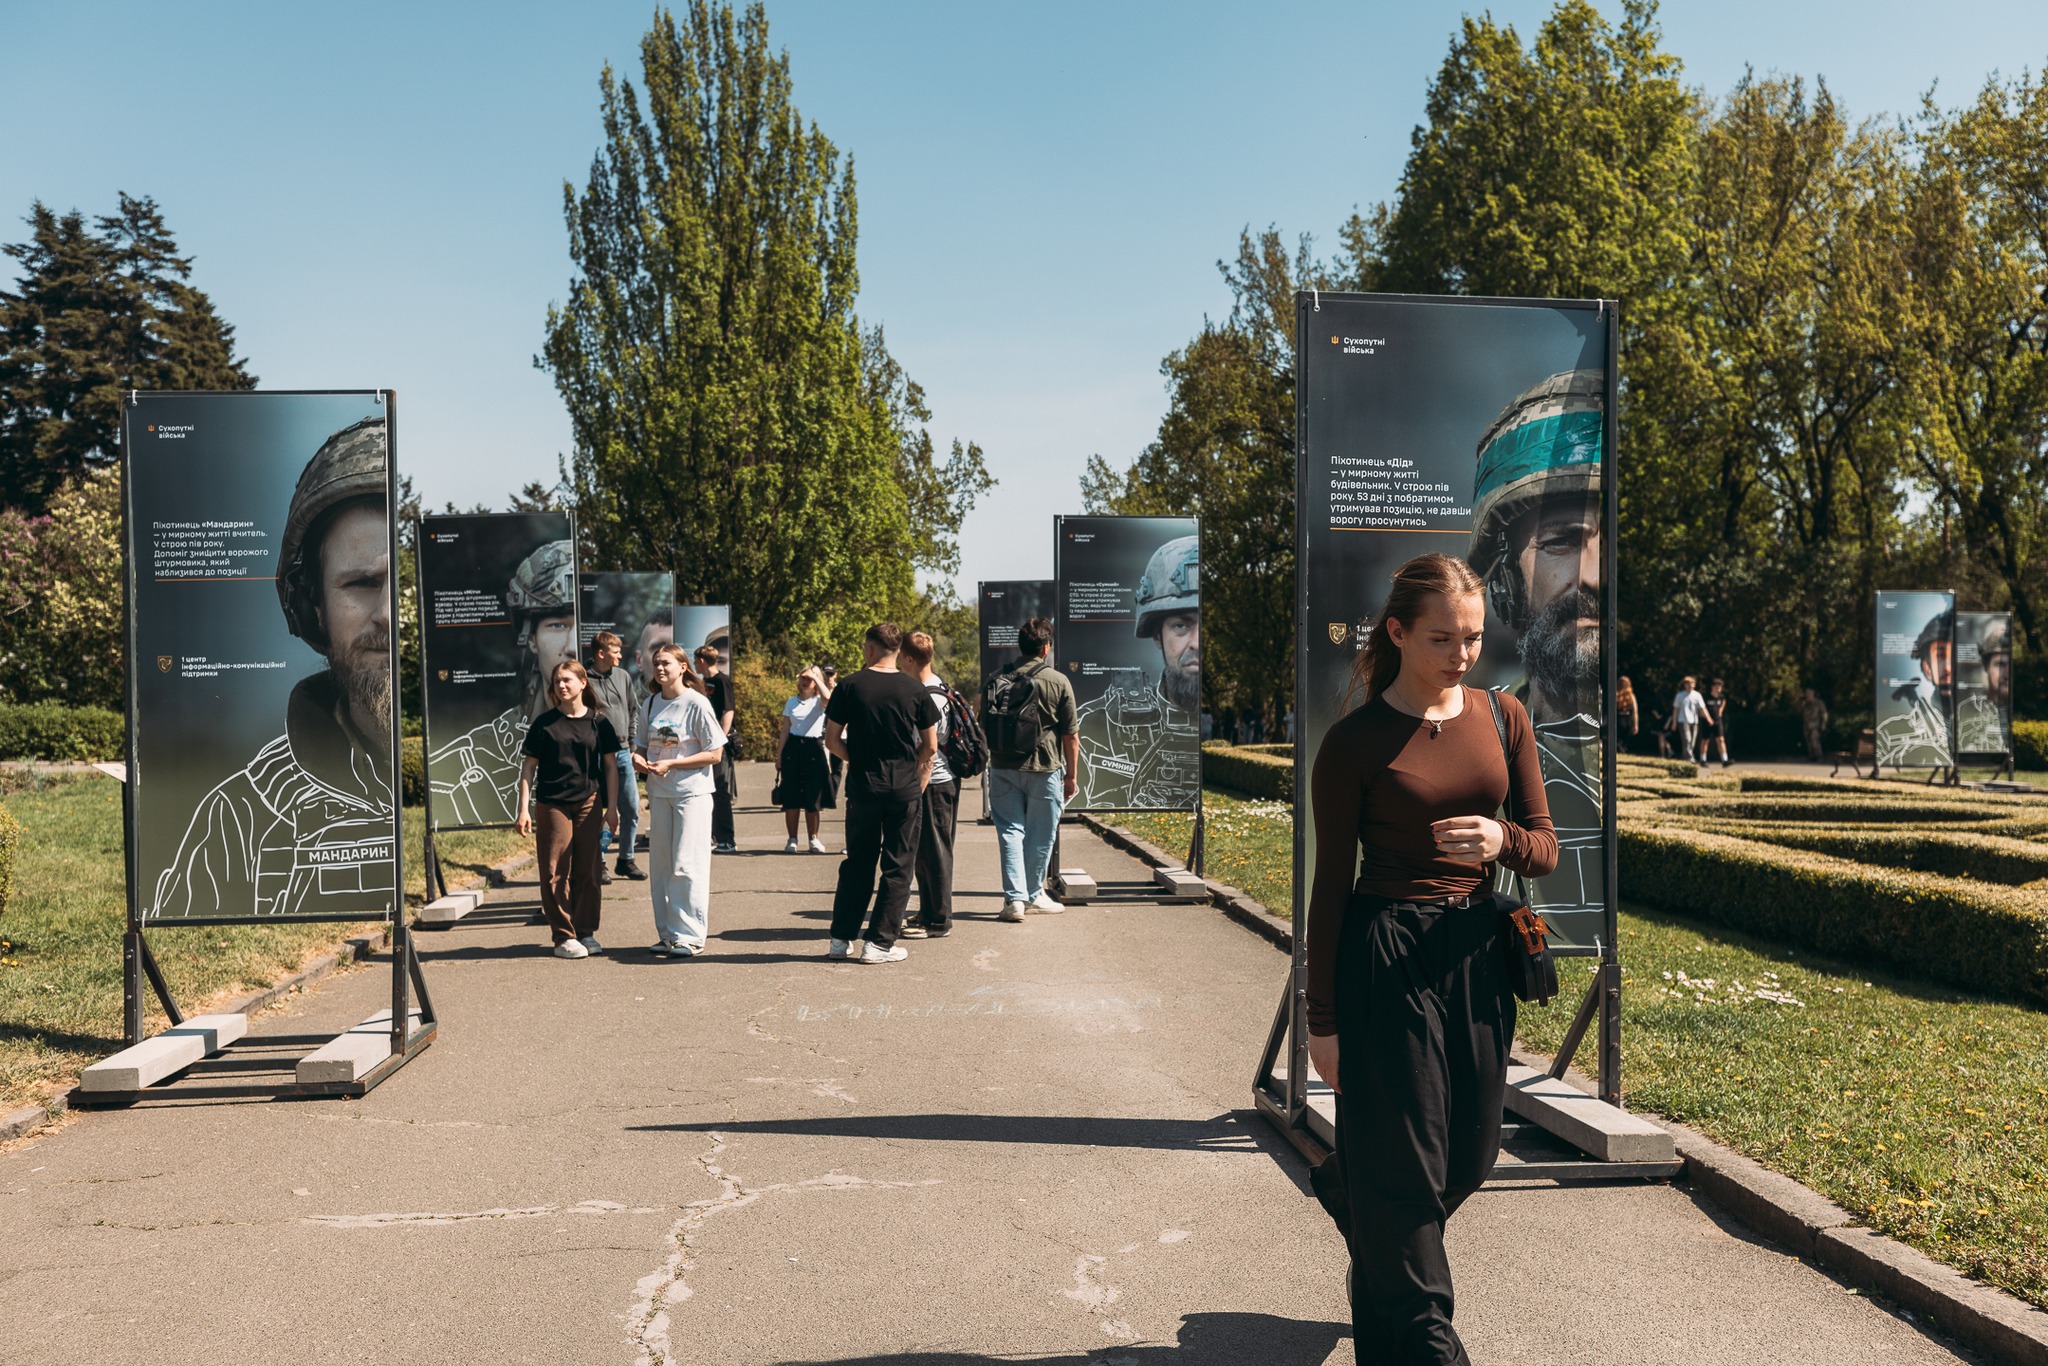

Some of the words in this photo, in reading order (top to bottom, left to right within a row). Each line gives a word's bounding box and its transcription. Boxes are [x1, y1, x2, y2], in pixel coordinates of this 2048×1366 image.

[1344, 337, 1384, 347] Сухопутні
[1344, 346, 1374, 354] війська
[1332, 456, 1385, 466] Піхотинець
[1387, 458, 1413, 468] «Дід»
[1348, 470, 1391, 479] мирному
[1394, 470, 1418, 478] житті
[1331, 480, 1392, 490] будівельник.
[1403, 484, 1432, 492] строю
[1435, 483, 1449, 491] пів
[1331, 493, 1354, 501] року.
[1357, 492, 1368, 500] 53
[1370, 492, 1385, 503] дні
[1394, 494, 1453, 503] побратимом
[1331, 505, 1380, 514] утримував
[1383, 505, 1424, 515] позицію,
[1440, 507, 1471, 516] давши
[1331, 517, 1363, 525] ворогу
[1366, 518, 1426, 526] просунутись
[190, 550, 226, 558] знищити
[154, 558, 208, 567] штурмовика,
[155, 569, 203, 577] наблизився
[218, 568, 247, 576] позиції
[182, 662, 286, 670] інформаційно-комунікаційної
[309, 846, 388, 862] МАНДАРИН
